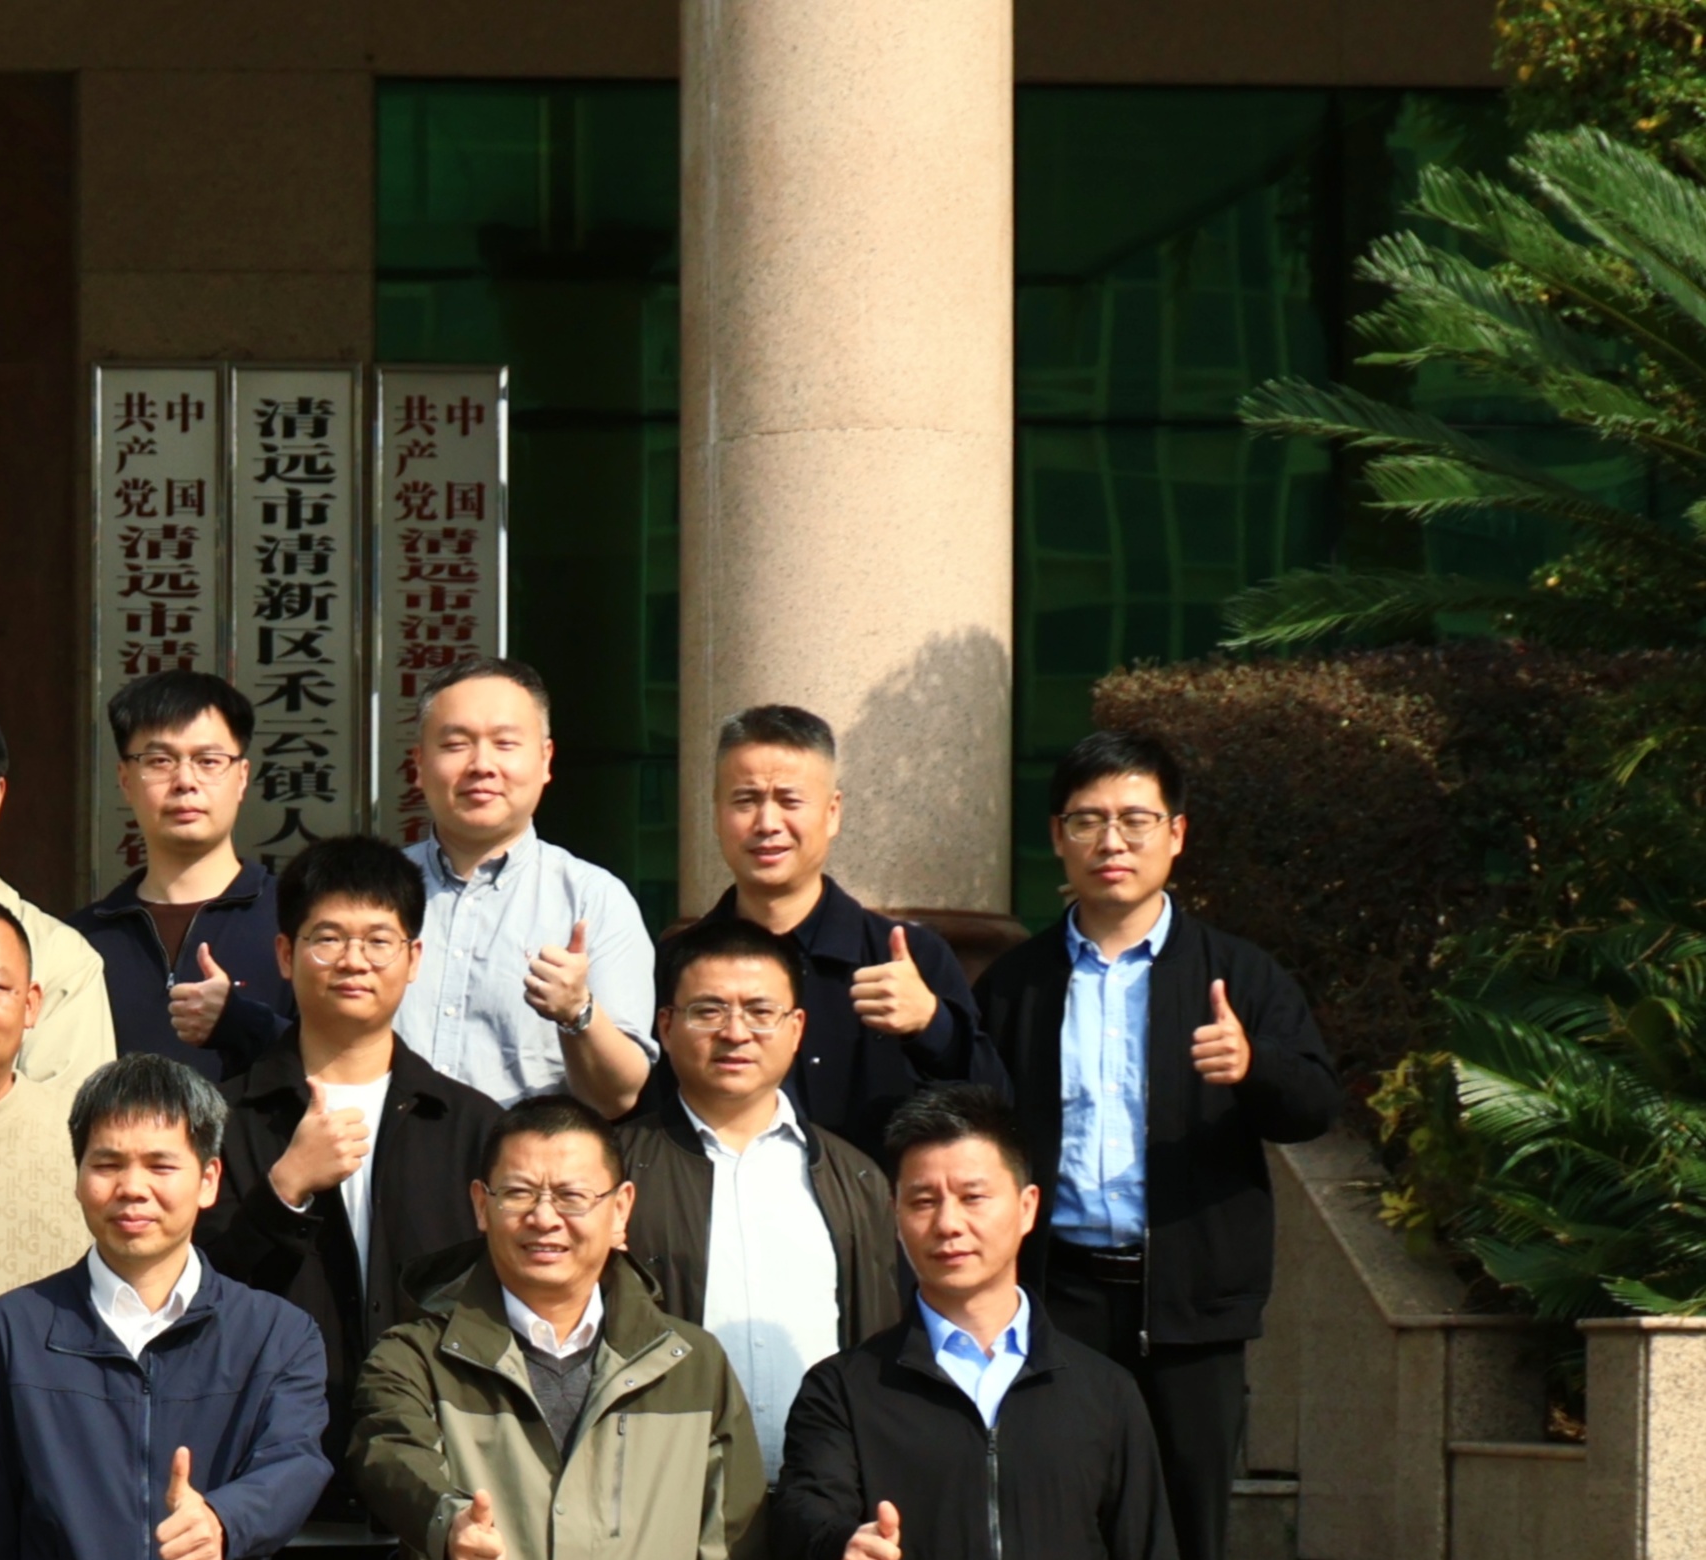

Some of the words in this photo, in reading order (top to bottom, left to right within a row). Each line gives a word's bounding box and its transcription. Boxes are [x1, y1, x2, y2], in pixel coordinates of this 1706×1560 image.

[252, 397, 337, 873] 清远市清新区禾云镇人
